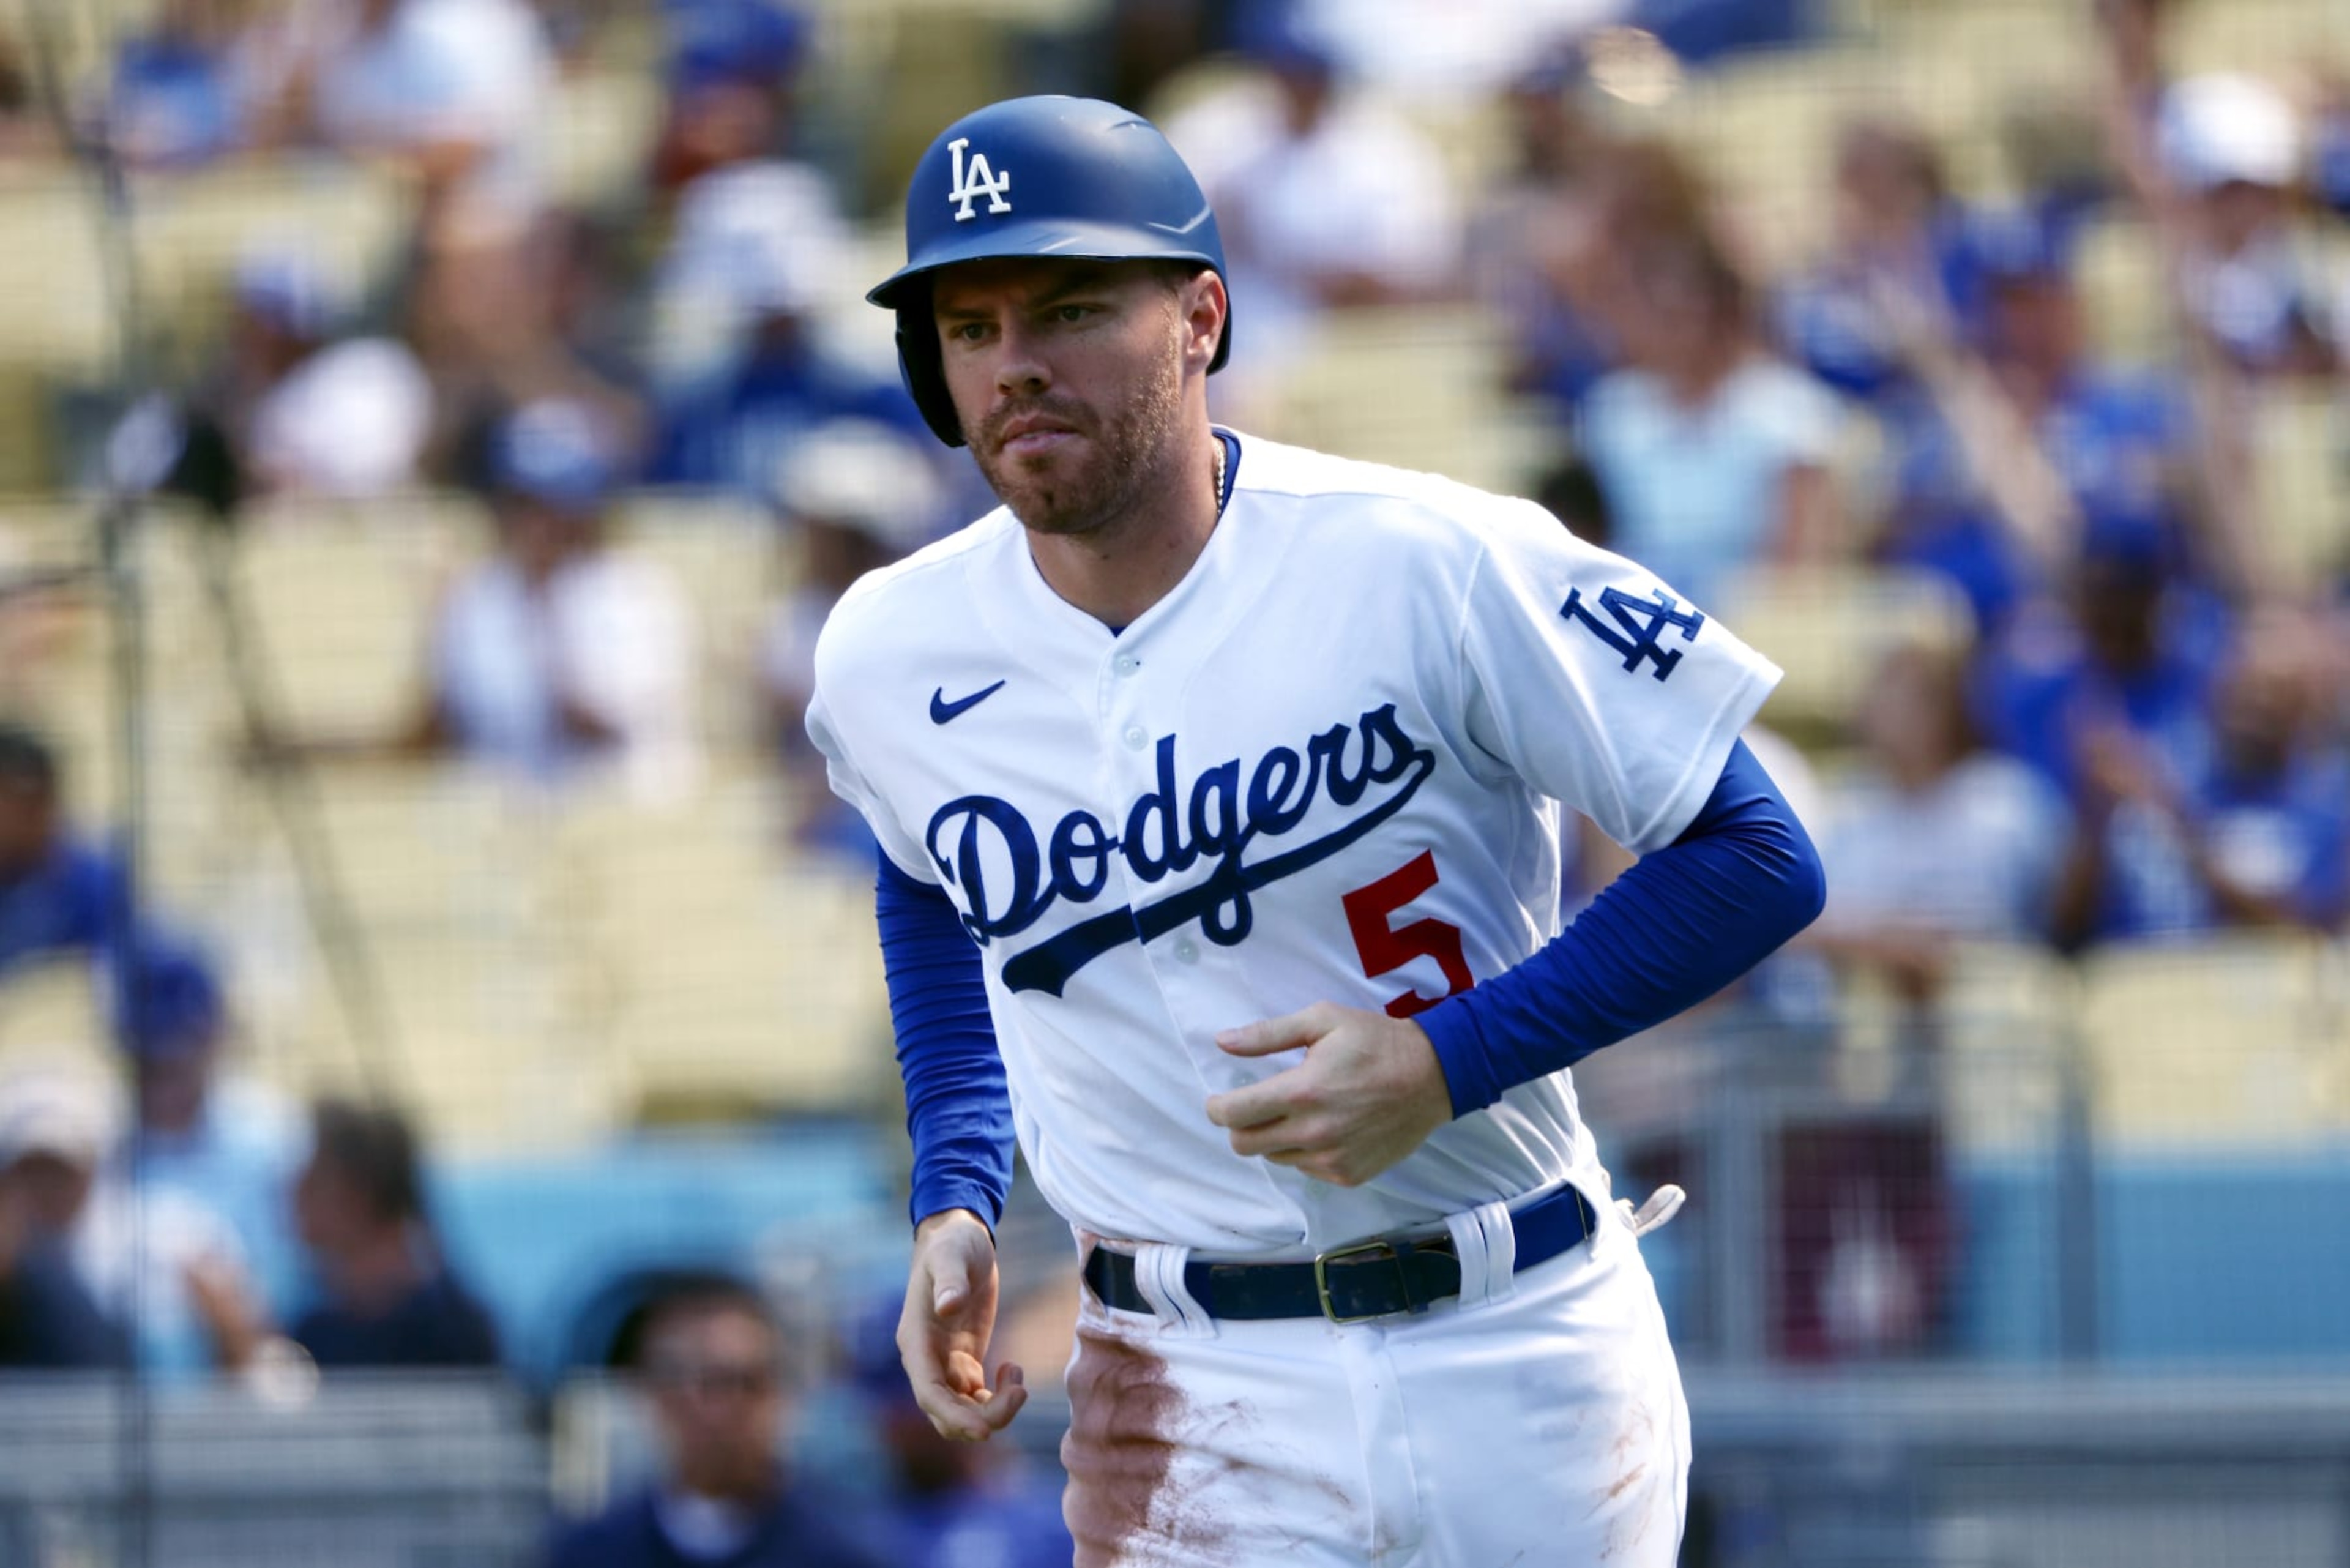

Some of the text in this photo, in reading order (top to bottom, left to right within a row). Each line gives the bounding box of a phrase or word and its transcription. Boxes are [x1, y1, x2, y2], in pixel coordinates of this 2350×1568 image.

[947, 138, 1012, 222] LA
[1559, 586, 1705, 682] LA
[925, 703, 1434, 947] Dodgers
[1341, 848, 1475, 1020] 5
